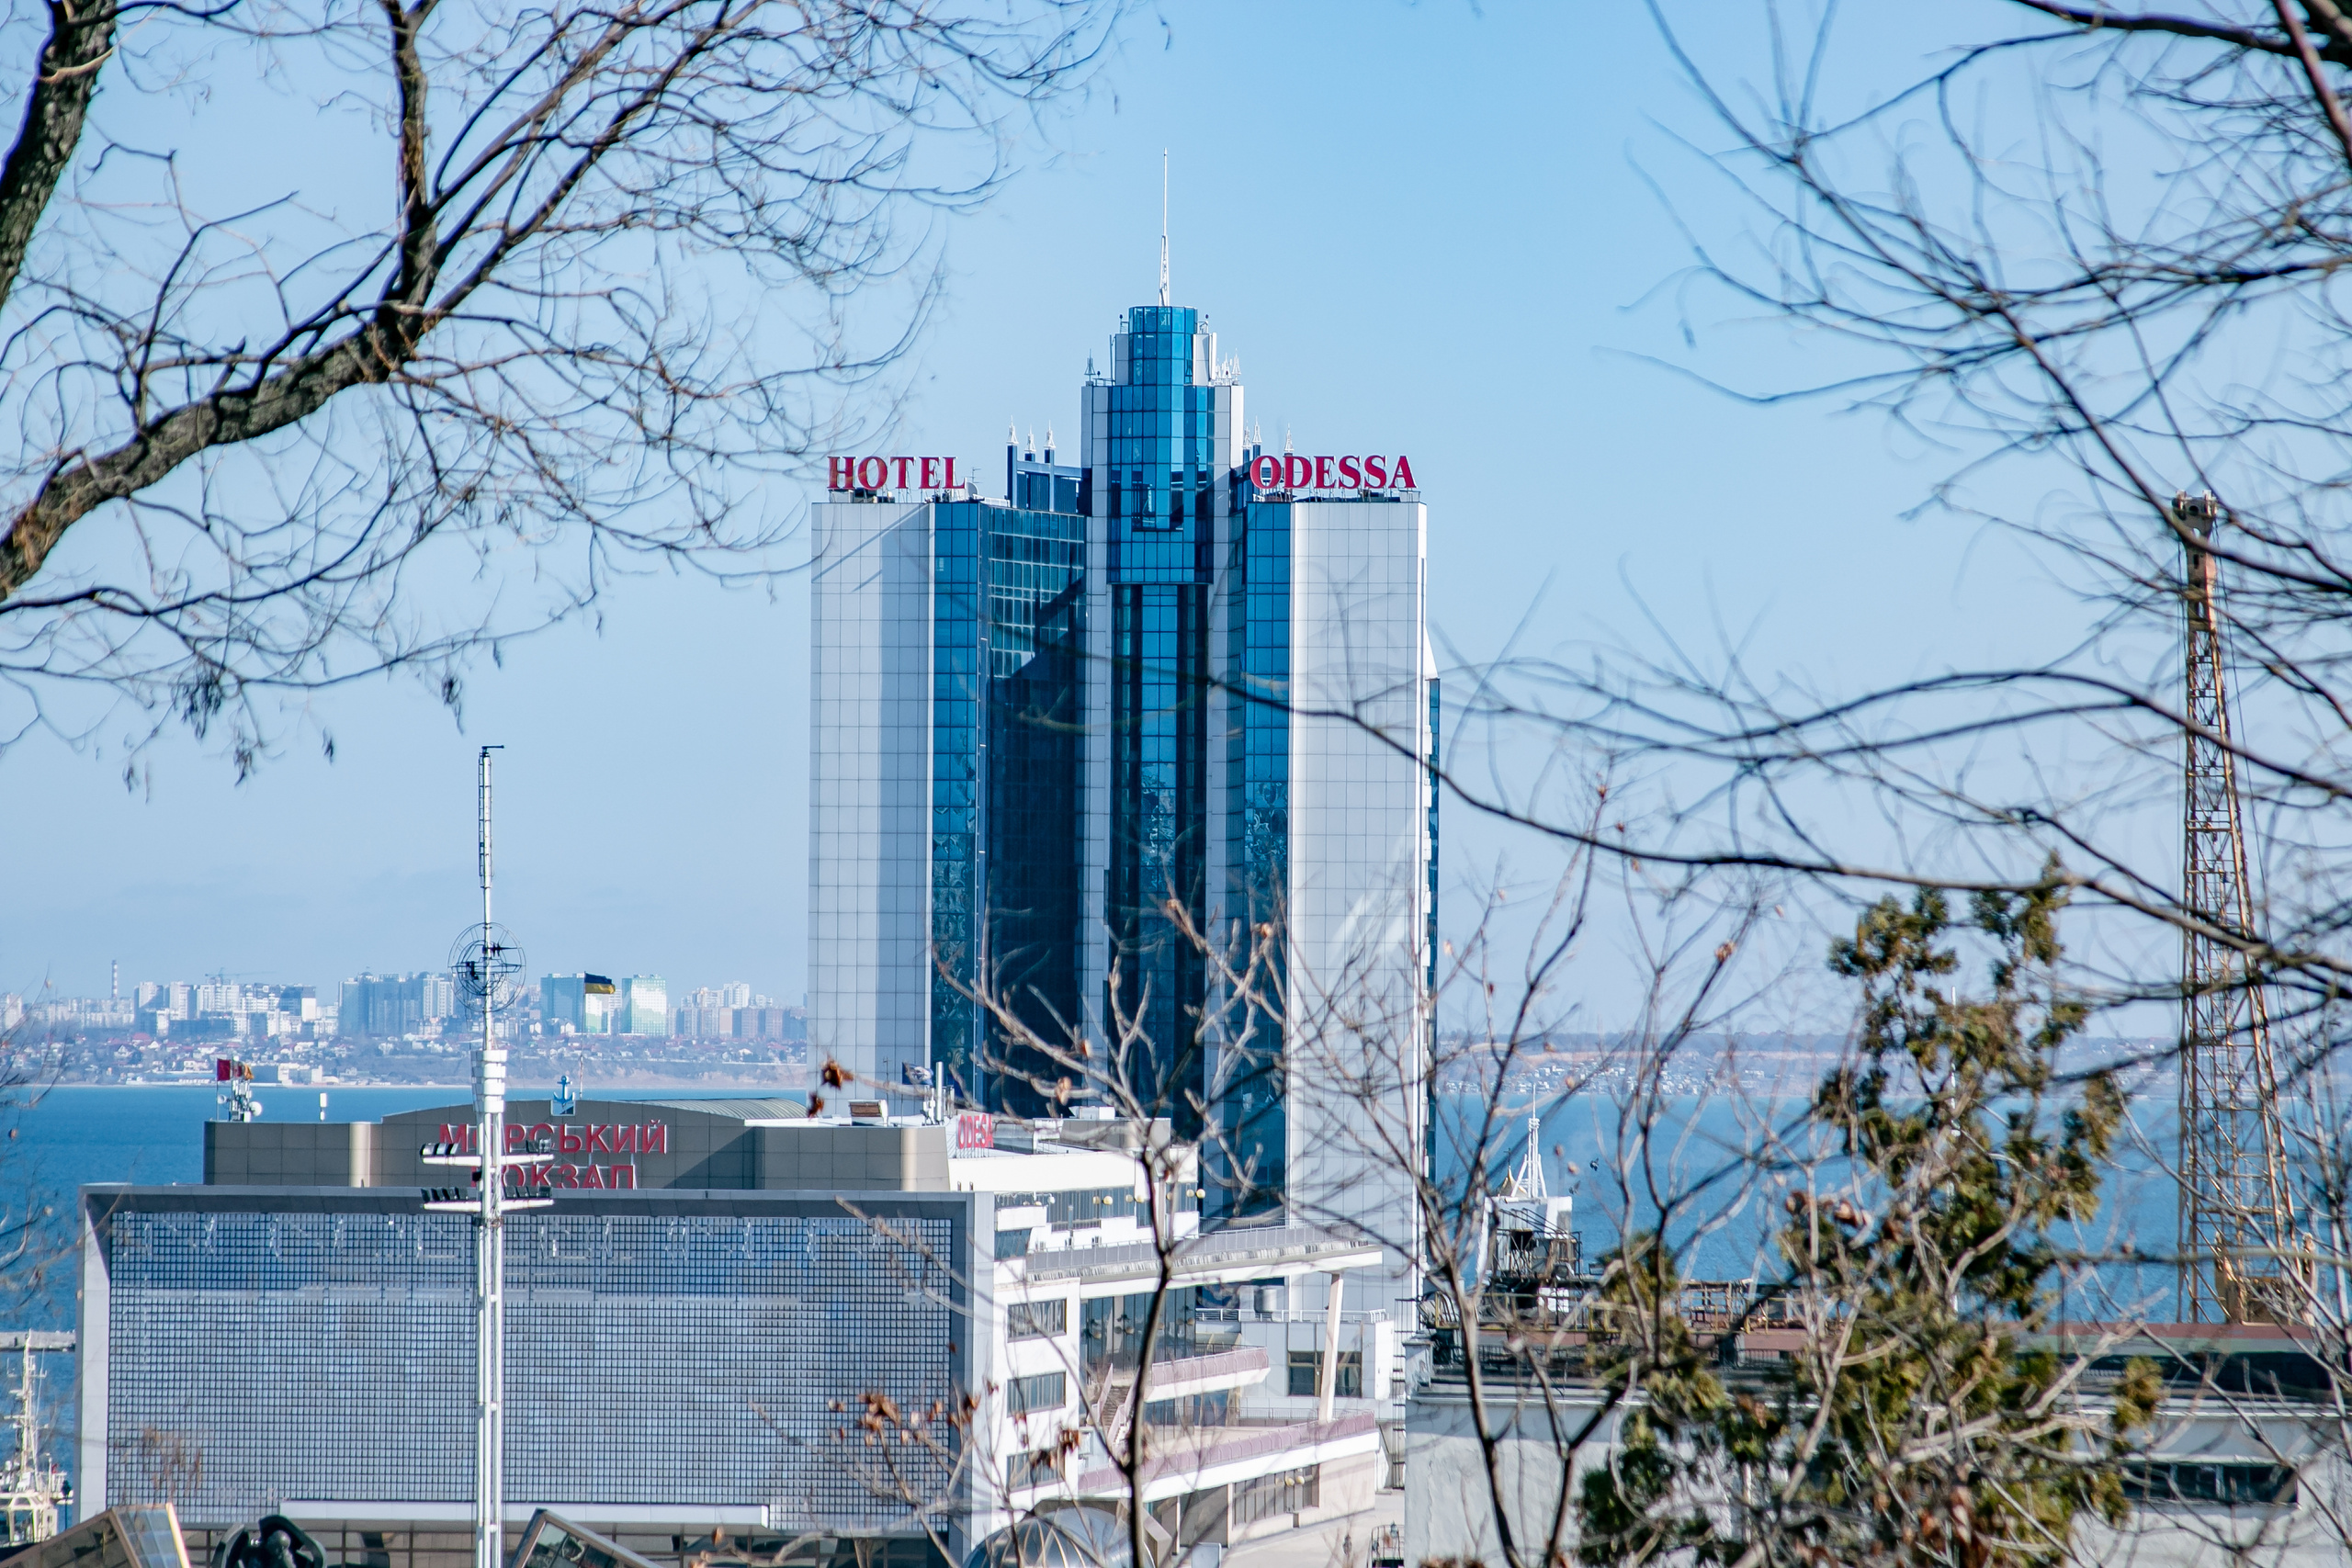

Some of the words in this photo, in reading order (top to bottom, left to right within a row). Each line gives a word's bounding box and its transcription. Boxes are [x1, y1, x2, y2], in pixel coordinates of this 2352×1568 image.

[827, 456, 966, 490] HOTEL
[1250, 455, 1418, 490] ODESSA
[439, 1120, 667, 1154] МРСЬКИЙ
[958, 1113, 994, 1149] ODESA
